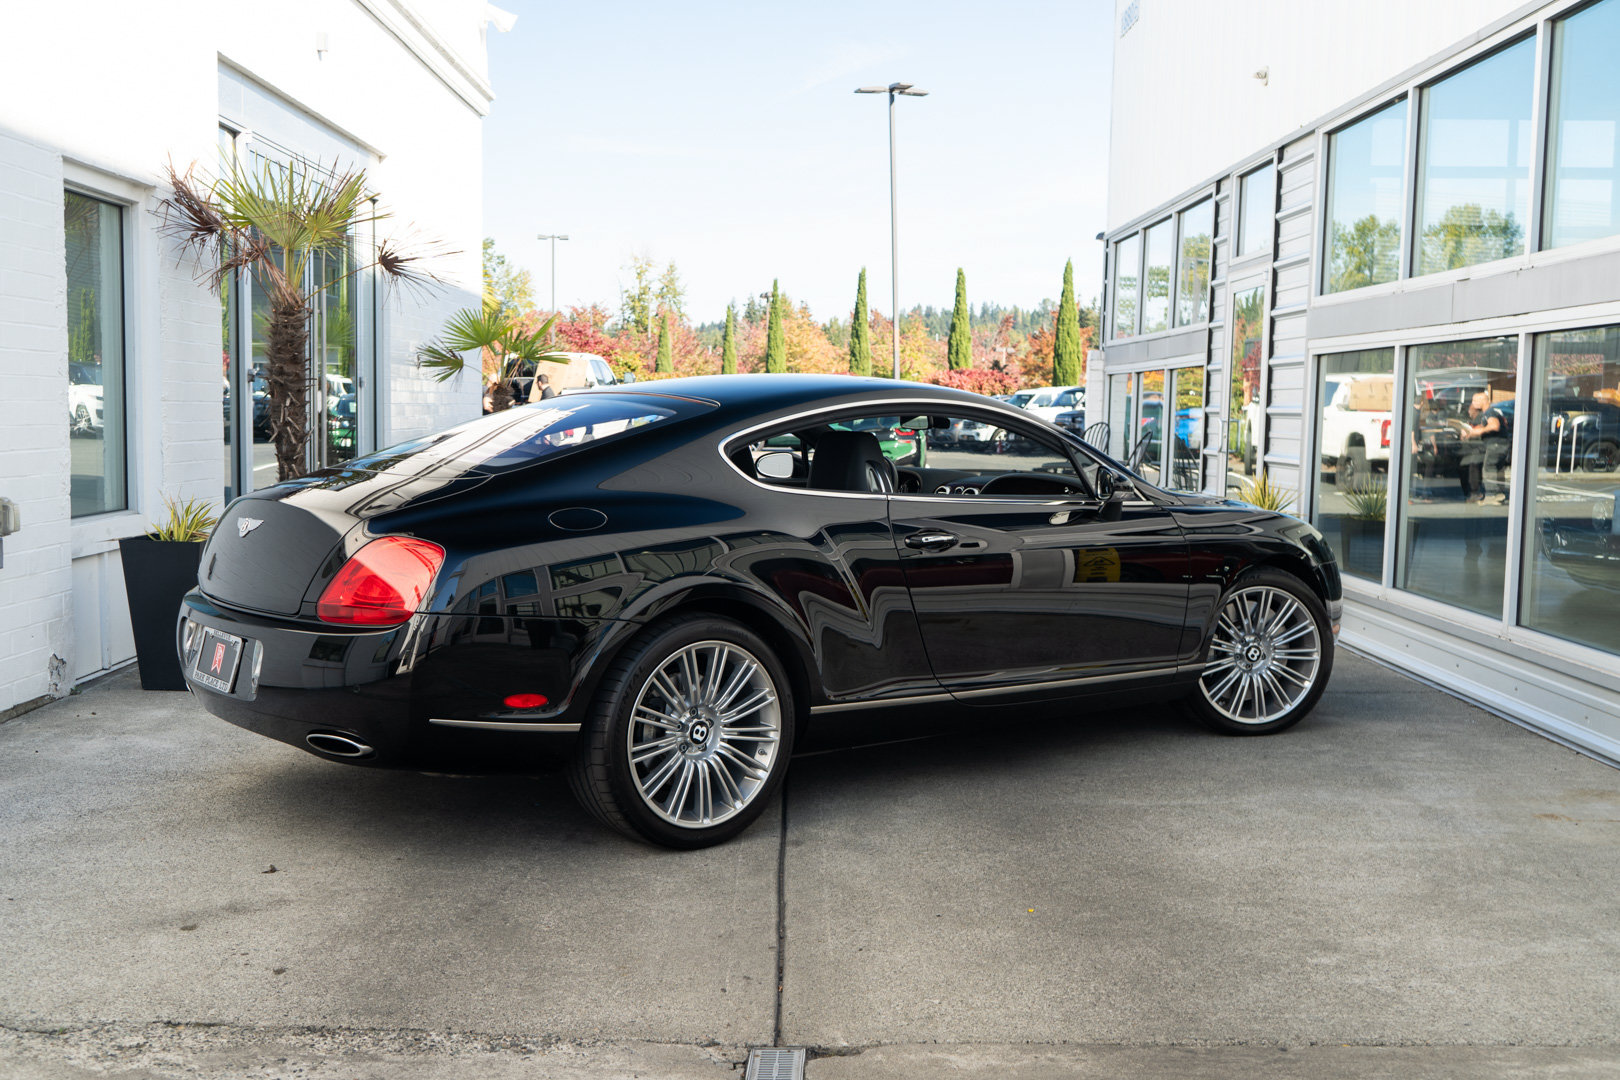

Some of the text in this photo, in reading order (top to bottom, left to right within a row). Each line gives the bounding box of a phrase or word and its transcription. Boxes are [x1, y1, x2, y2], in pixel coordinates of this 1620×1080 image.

[213, 629, 231, 641] BELLEVUE
[1248, 647, 1260, 661] B
[194, 671, 229, 691] PARK PLACE LTD
[693, 724, 707, 742] B
